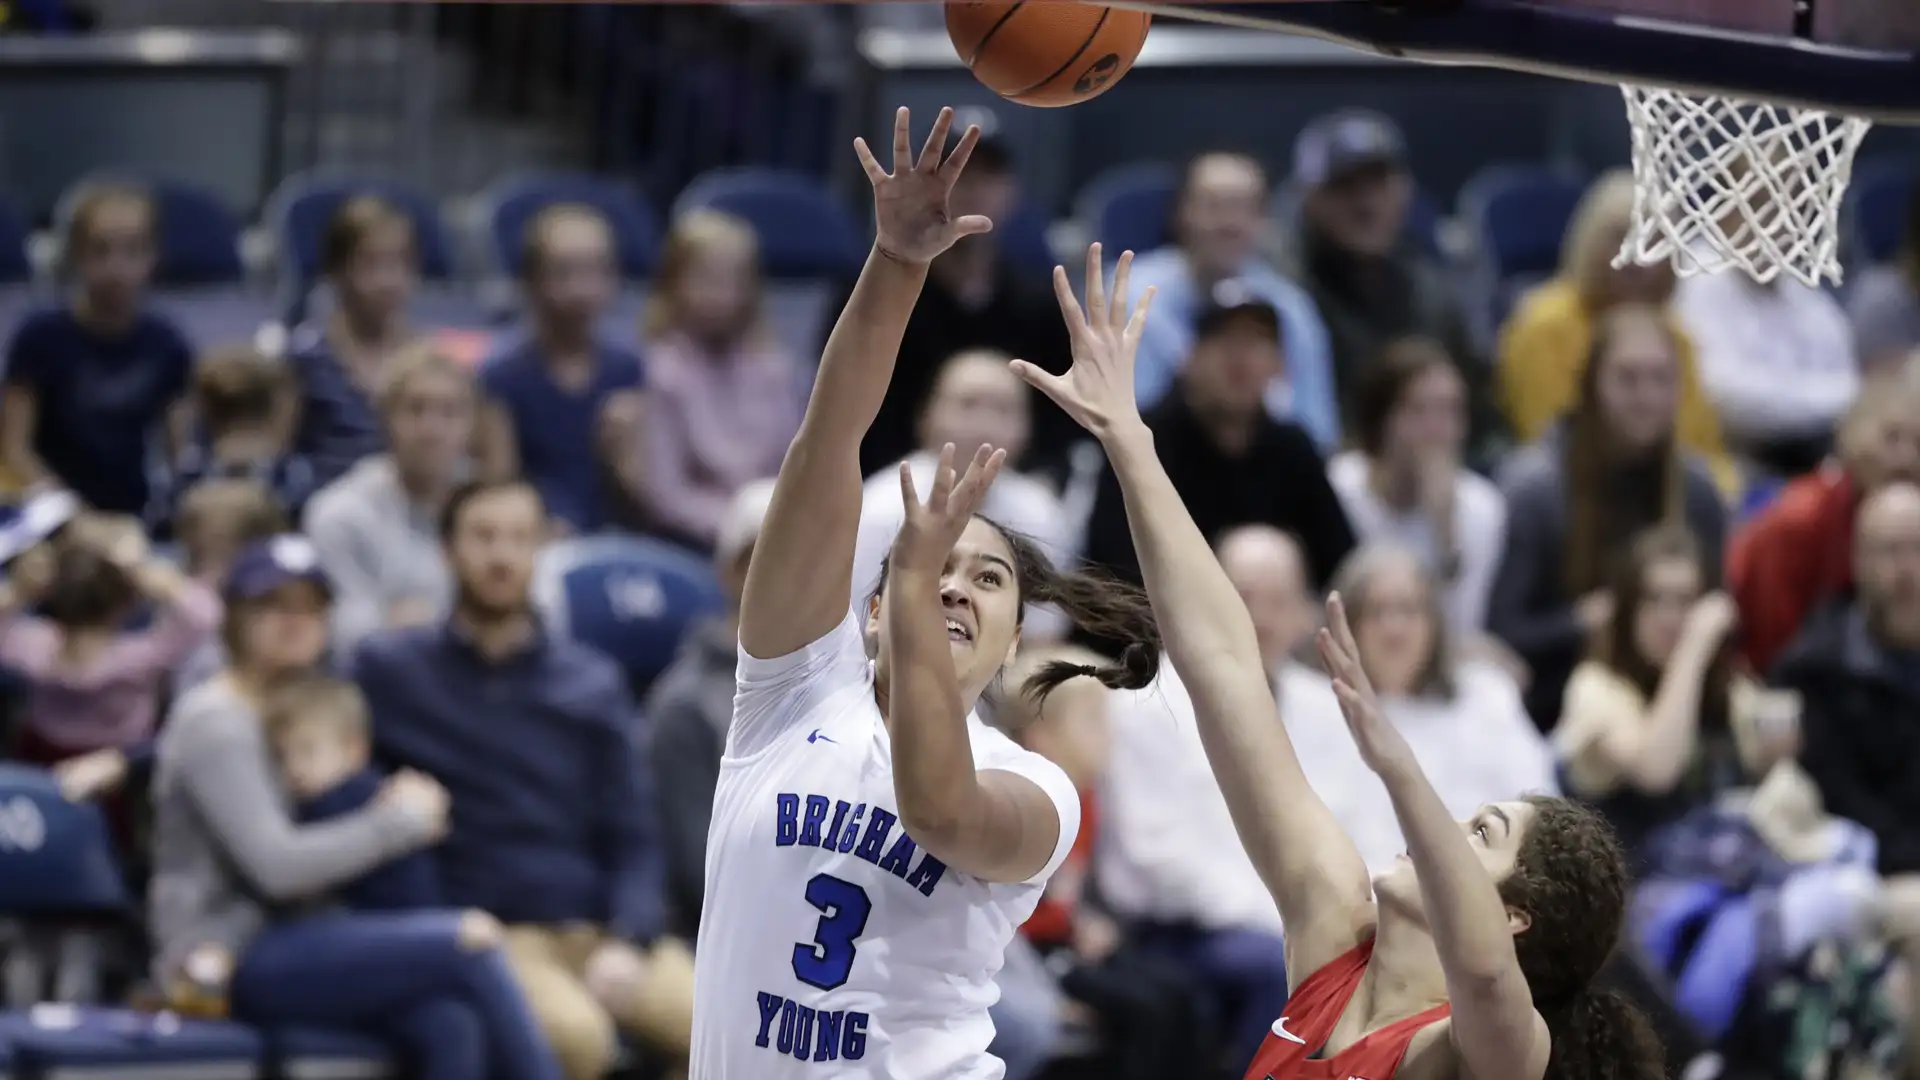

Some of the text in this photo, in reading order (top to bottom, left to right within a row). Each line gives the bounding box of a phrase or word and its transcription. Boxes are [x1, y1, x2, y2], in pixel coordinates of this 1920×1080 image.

[776, 793, 947, 897] BRIGHAM
[792, 872, 872, 991] 3
[755, 991, 869, 1062] YOUNG
